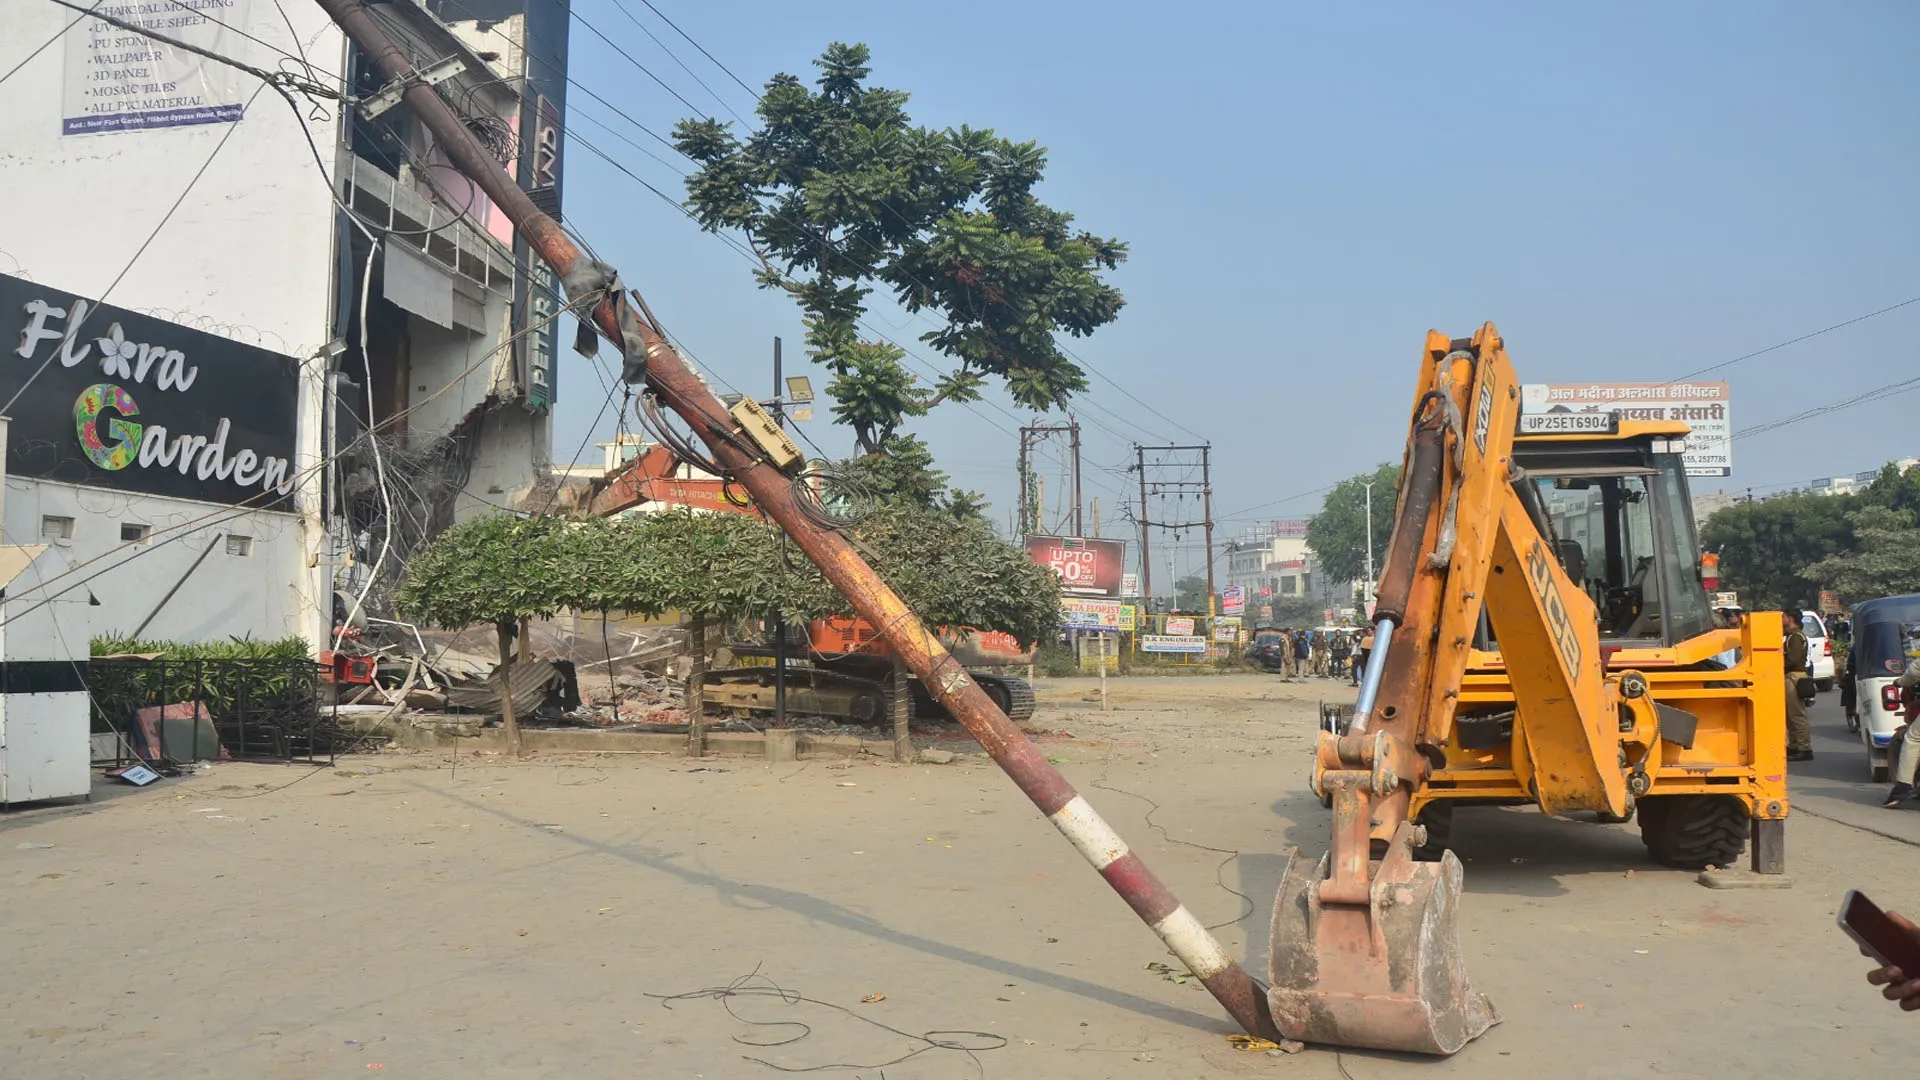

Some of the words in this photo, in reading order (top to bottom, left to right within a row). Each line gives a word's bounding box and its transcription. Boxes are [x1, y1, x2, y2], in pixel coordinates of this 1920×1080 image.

[95, 23, 112, 32] UV
[167, 16, 207, 28] SHEET
[94, 38, 111, 48] PU
[94, 51, 162, 64] WALLPAPER
[93, 71, 110, 81] 3D
[114, 69, 150, 79] PANEL
[92, 84, 141, 97] MOSAIC
[143, 81, 176, 93] TILES
[91, 103, 117, 114] ALL
[142, 95, 205, 110] MATERIAL
[1551, 388, 1574, 399] अल
[1670, 403, 1725, 420] अंसारी
[1529, 416, 1608, 429] UP25ET6904
[73, 383, 297, 496] Garden
[688, 490, 717, 500] HITACHI
[1052, 550, 1094, 562] UPTO
[1086, 604, 1120, 614] FLORIST
[1530, 552, 1581, 680] JCB
